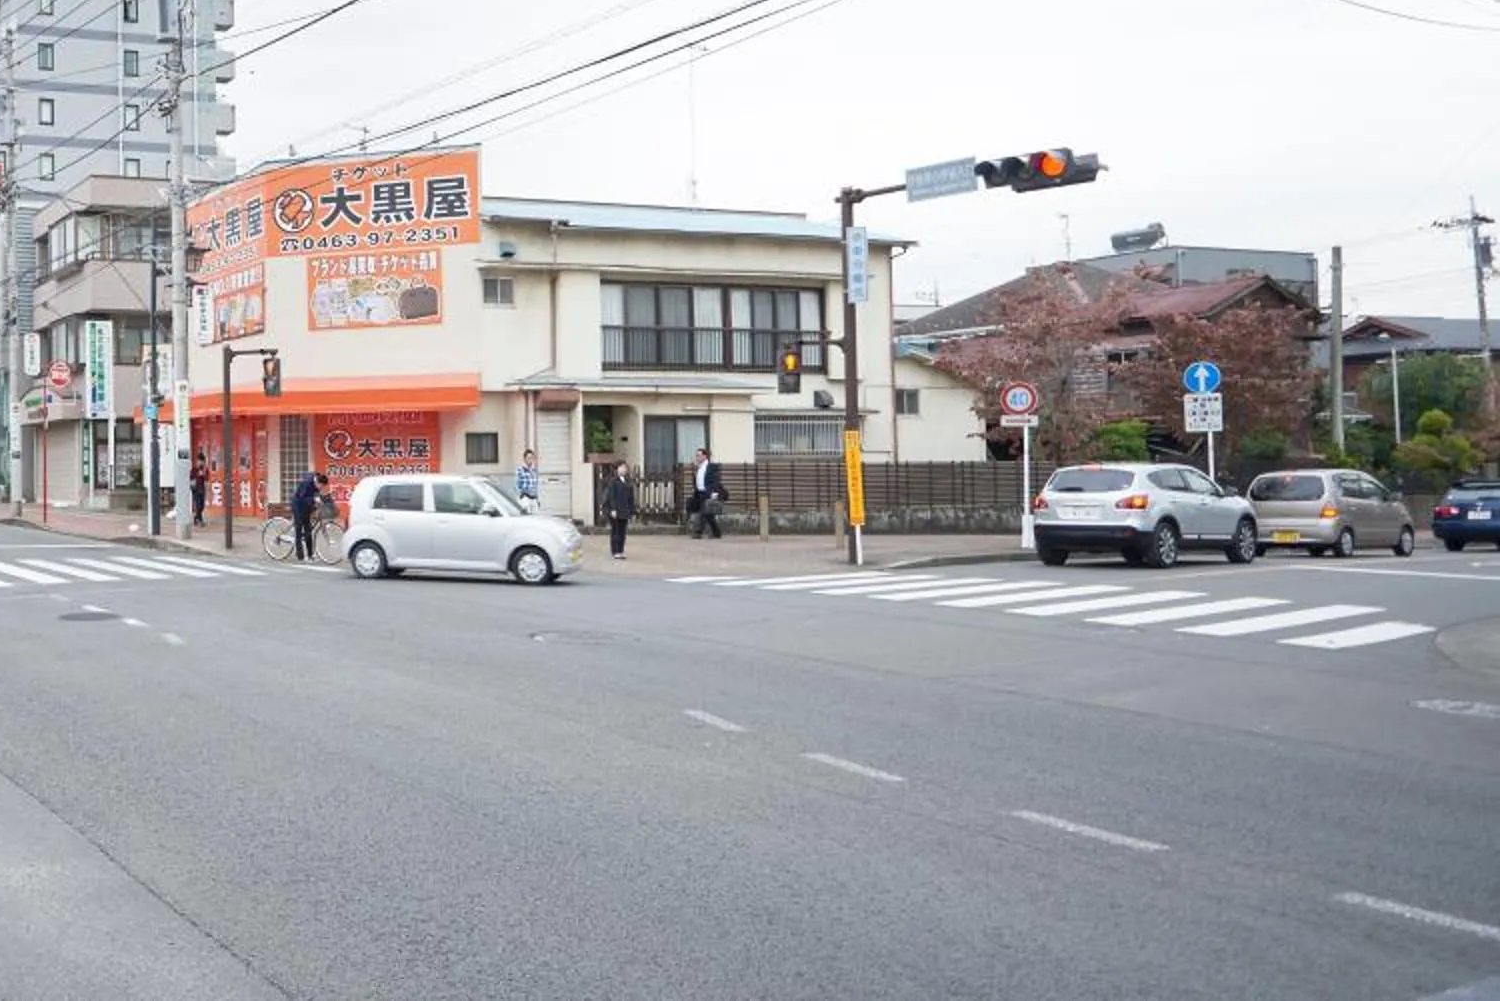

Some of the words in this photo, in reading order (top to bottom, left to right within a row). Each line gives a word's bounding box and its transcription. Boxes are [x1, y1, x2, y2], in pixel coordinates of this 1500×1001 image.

[333, 163, 407, 181] チケット
[319, 177, 470, 228] 大黒屋
[358, 438, 430, 459] 大黒屋
